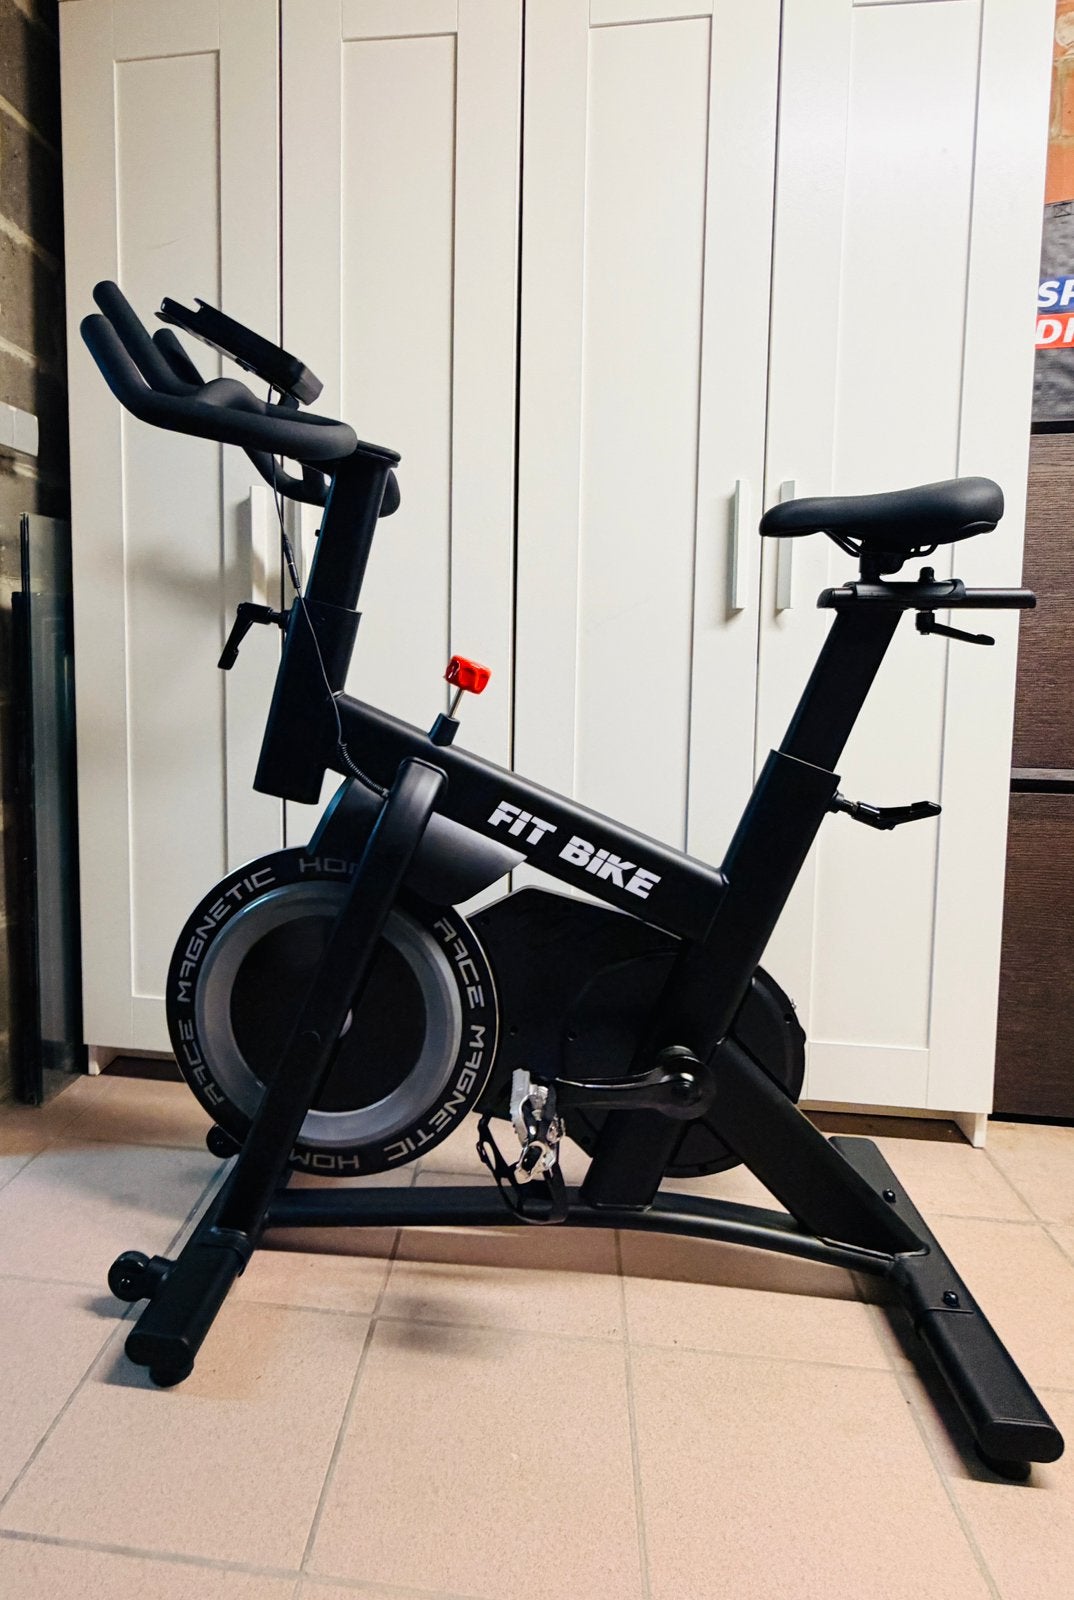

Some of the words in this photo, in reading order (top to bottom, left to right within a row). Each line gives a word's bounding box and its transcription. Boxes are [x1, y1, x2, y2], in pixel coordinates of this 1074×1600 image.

[487, 800, 558, 846] FIT
[558, 835, 662, 900] BIKE
[177, 867, 276, 1003] MAGNETIC
[433, 916, 486, 1010] RACE
[178, 1018, 226, 1106] RACE
[383, 1024, 487, 1162] MAGNETIC
